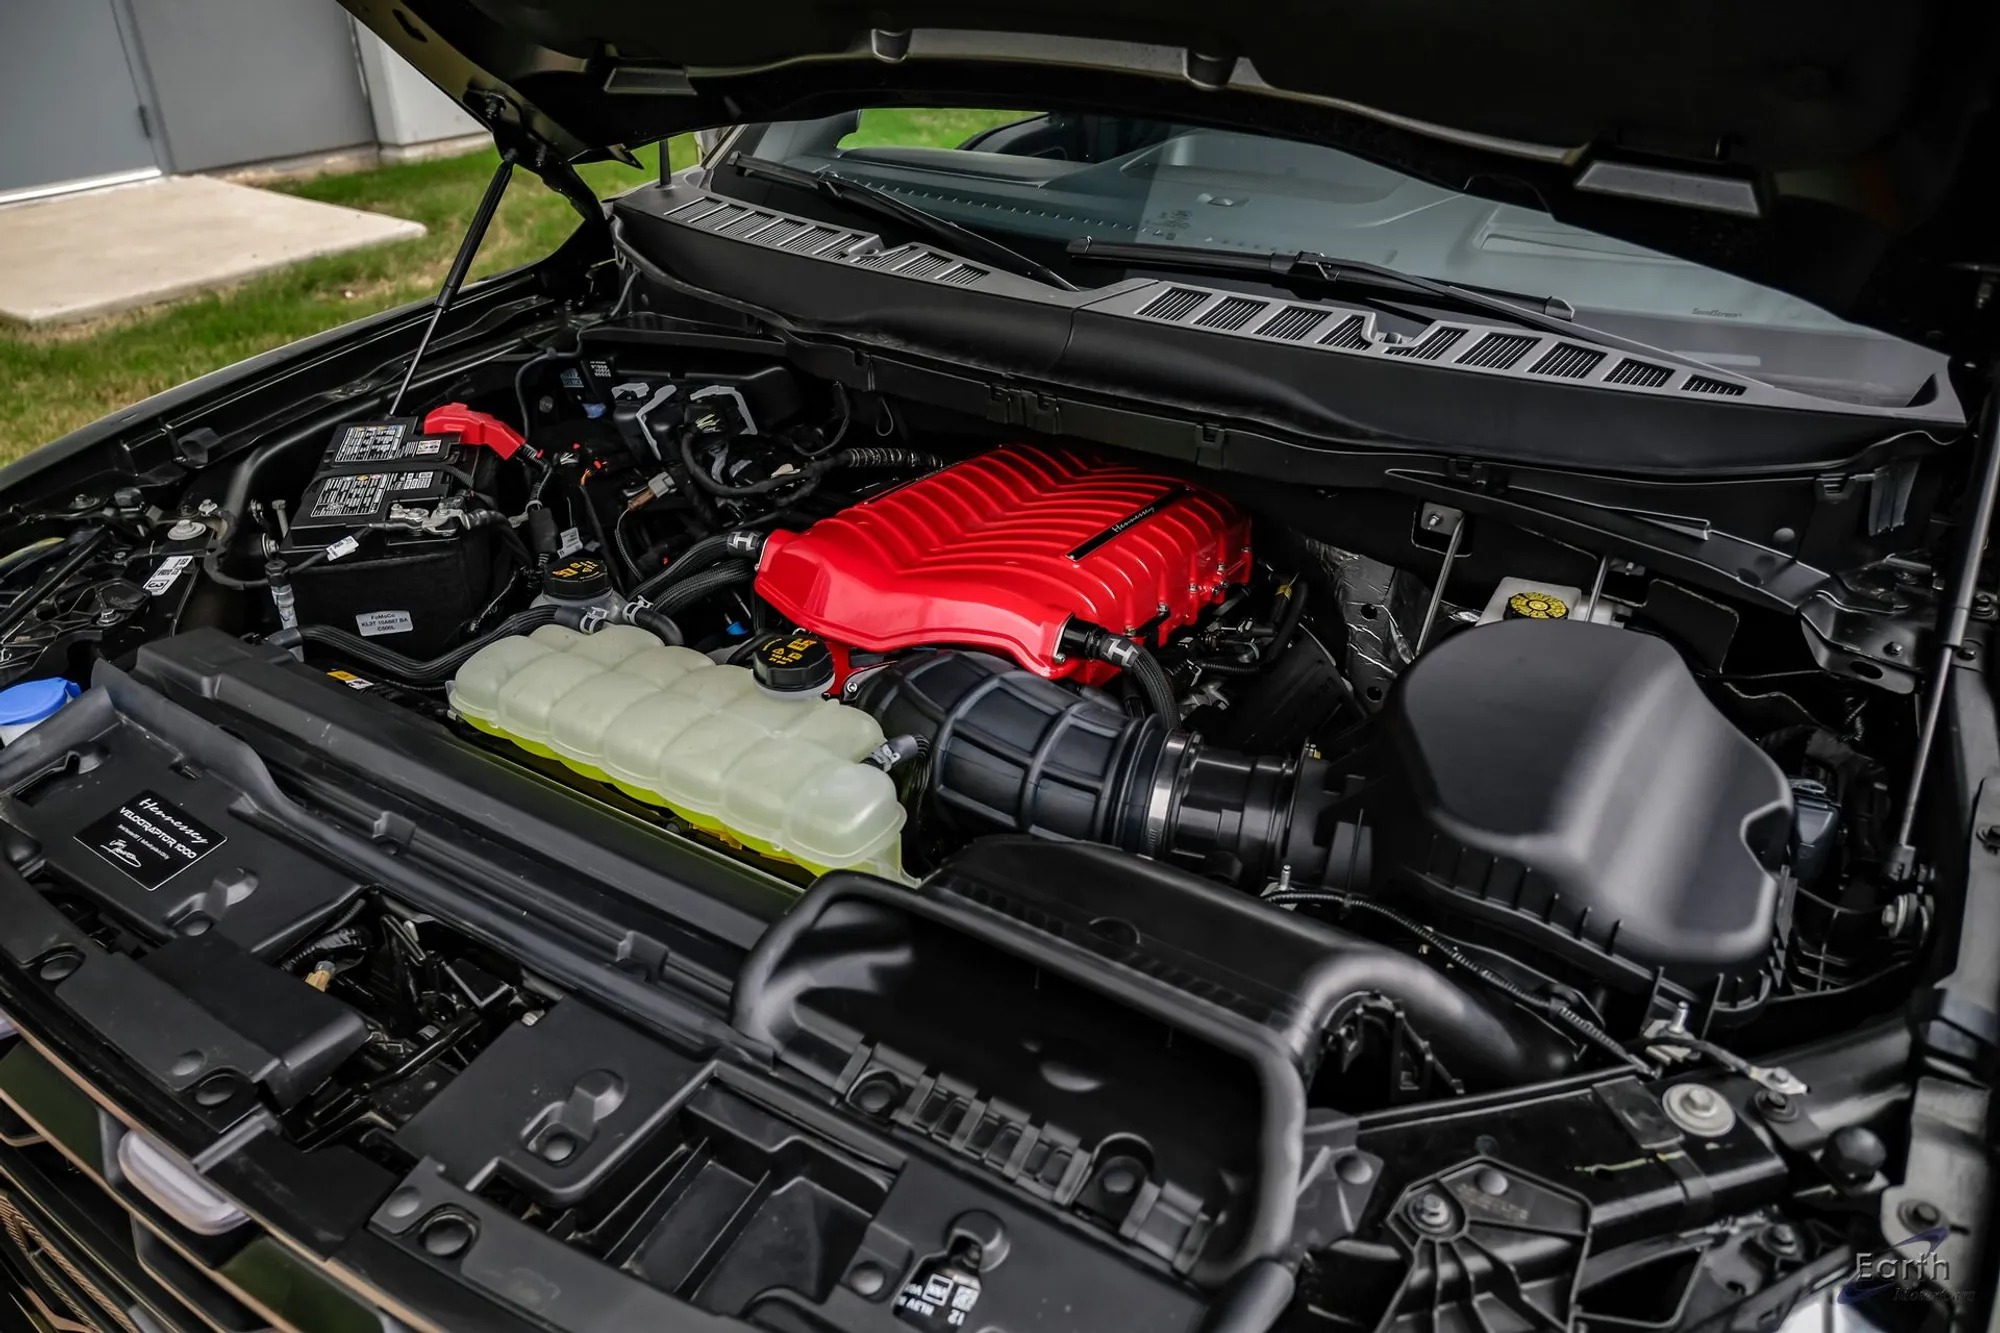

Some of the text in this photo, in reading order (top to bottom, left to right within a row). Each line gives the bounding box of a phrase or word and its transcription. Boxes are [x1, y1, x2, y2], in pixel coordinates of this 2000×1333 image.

[1111, 507, 1155, 532] Hennessey
[119, 806, 178, 848] VELOCIRAPTOR
[174, 843, 198, 860] 1000
[138, 798, 209, 844] Hennessey
